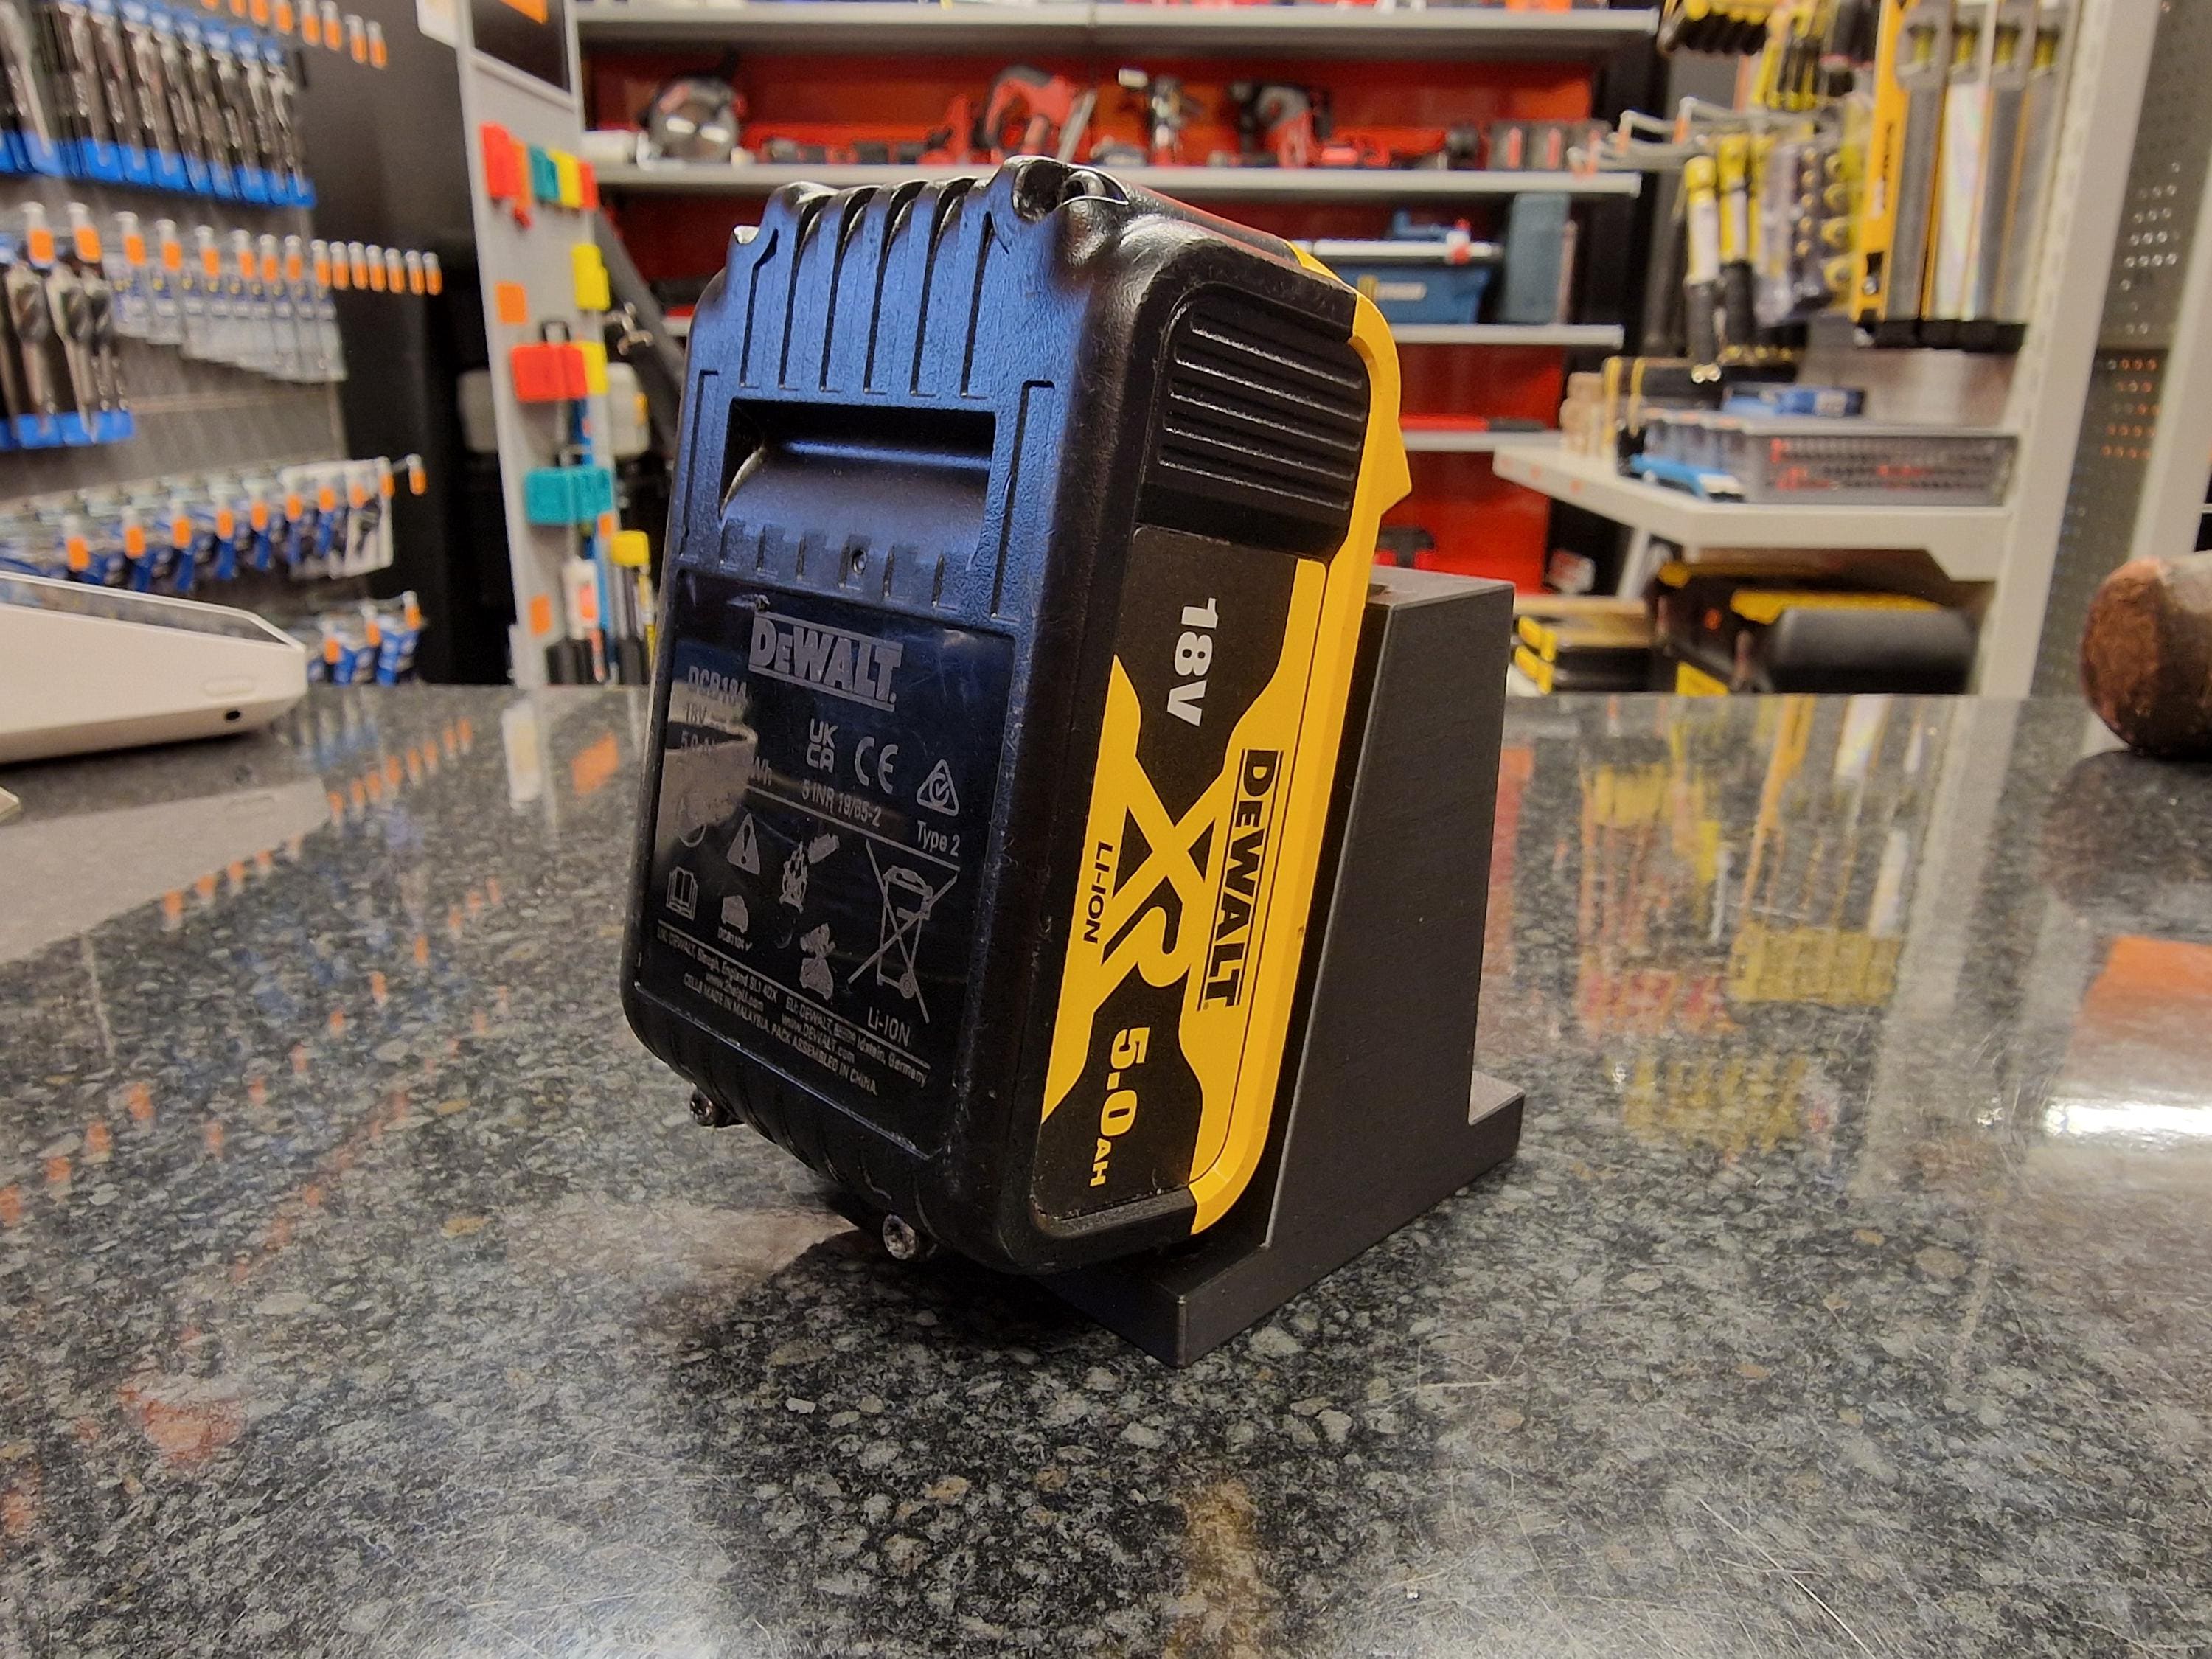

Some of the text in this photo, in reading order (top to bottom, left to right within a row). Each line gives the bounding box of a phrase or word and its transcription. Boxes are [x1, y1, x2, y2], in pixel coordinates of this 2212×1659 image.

[1166, 597, 1219, 727] 18V
[807, 742, 835, 773] CA
[810, 718, 838, 749] UK
[855, 736, 899, 795] CE
[917, 819, 961, 857] Type 2
[1082, 841, 1113, 945] LI-ION
[1099, 756, 1227, 989] XR
[1205, 749, 1279, 1007] DEWALT
[771, 1023, 791, 1044] PACK
[791, 1034, 839, 1071] ASSEMBLED
[838, 1062, 849, 1079] IN
[867, 1006, 911, 1048] Li-ION
[888, 1051, 928, 1088] Germany
